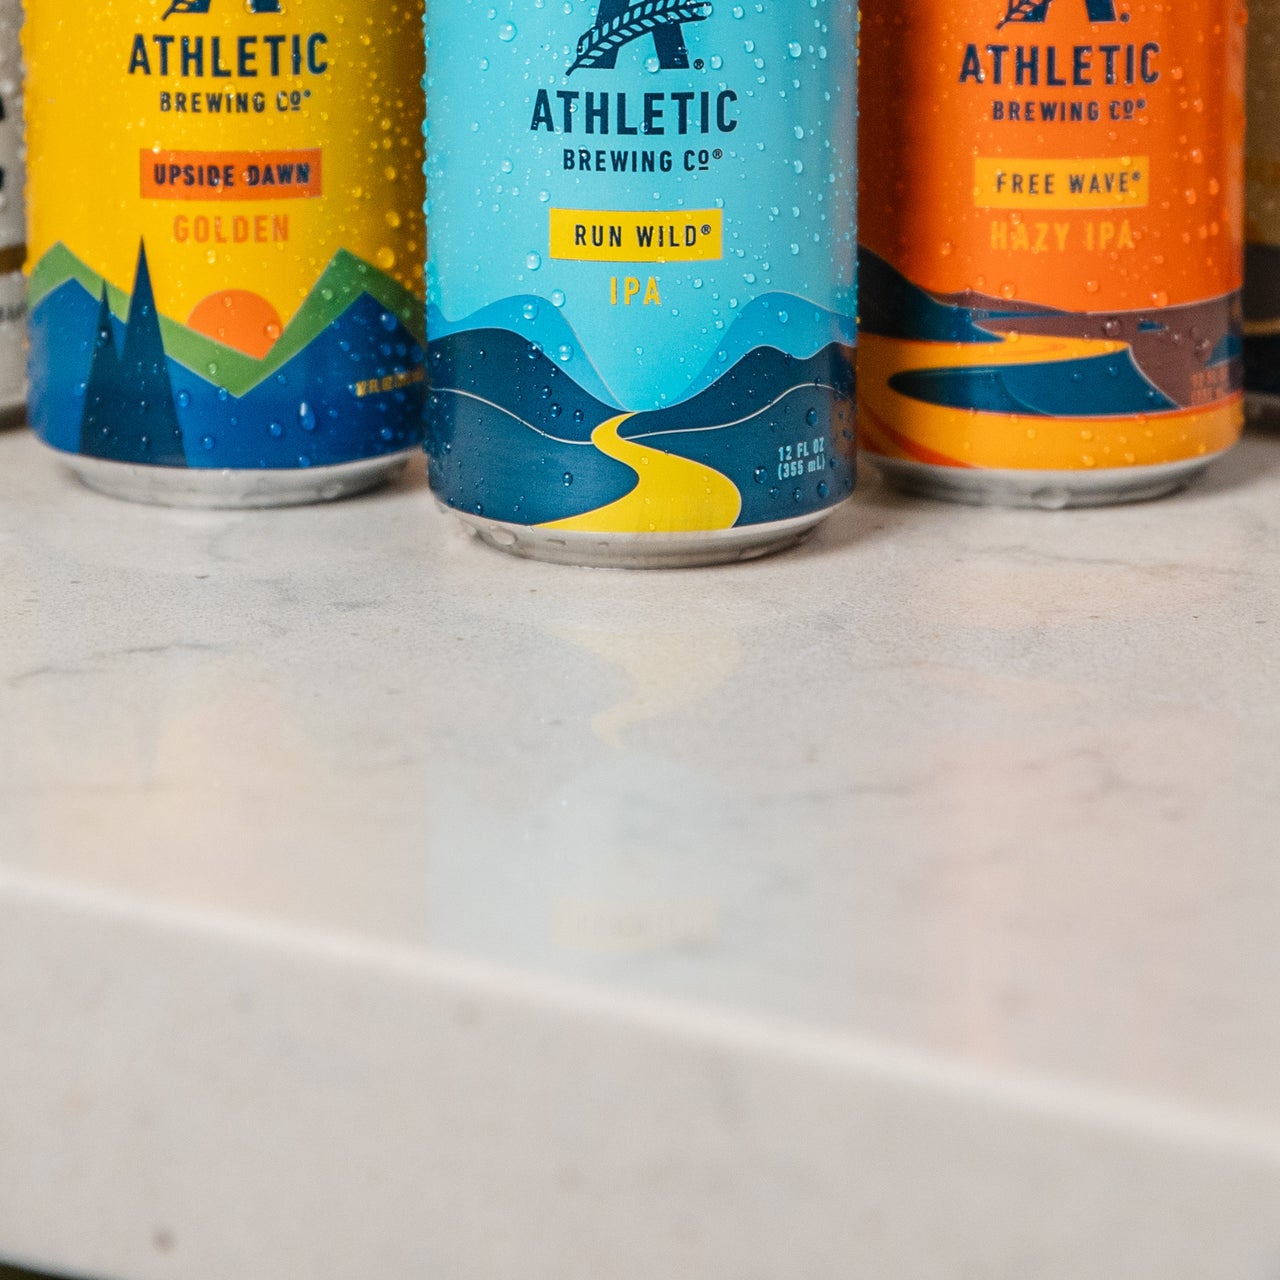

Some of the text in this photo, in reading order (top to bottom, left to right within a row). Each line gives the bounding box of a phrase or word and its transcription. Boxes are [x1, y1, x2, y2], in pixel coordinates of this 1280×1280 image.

[128, 33, 329, 77] ATHLETIC
[958, 42, 1161, 86] ATHLETIC
[159, 92, 266, 114] BREWING
[530, 89, 738, 135] ATHLETIC
[992, 100, 1100, 121] BREWING
[563, 149, 673, 172] BREWING
[154, 162, 311, 187] UPSIDE DAWN
[996, 173, 1056, 195] FREE
[173, 214, 290, 244] GOLDEN
[575, 224, 622, 247] RUN
[990, 220, 1135, 252] HAZY IPA
[610, 276, 662, 305] IPA
[778, 436, 825, 461] 12 FL OZ
[778, 459, 803, 480] (355
